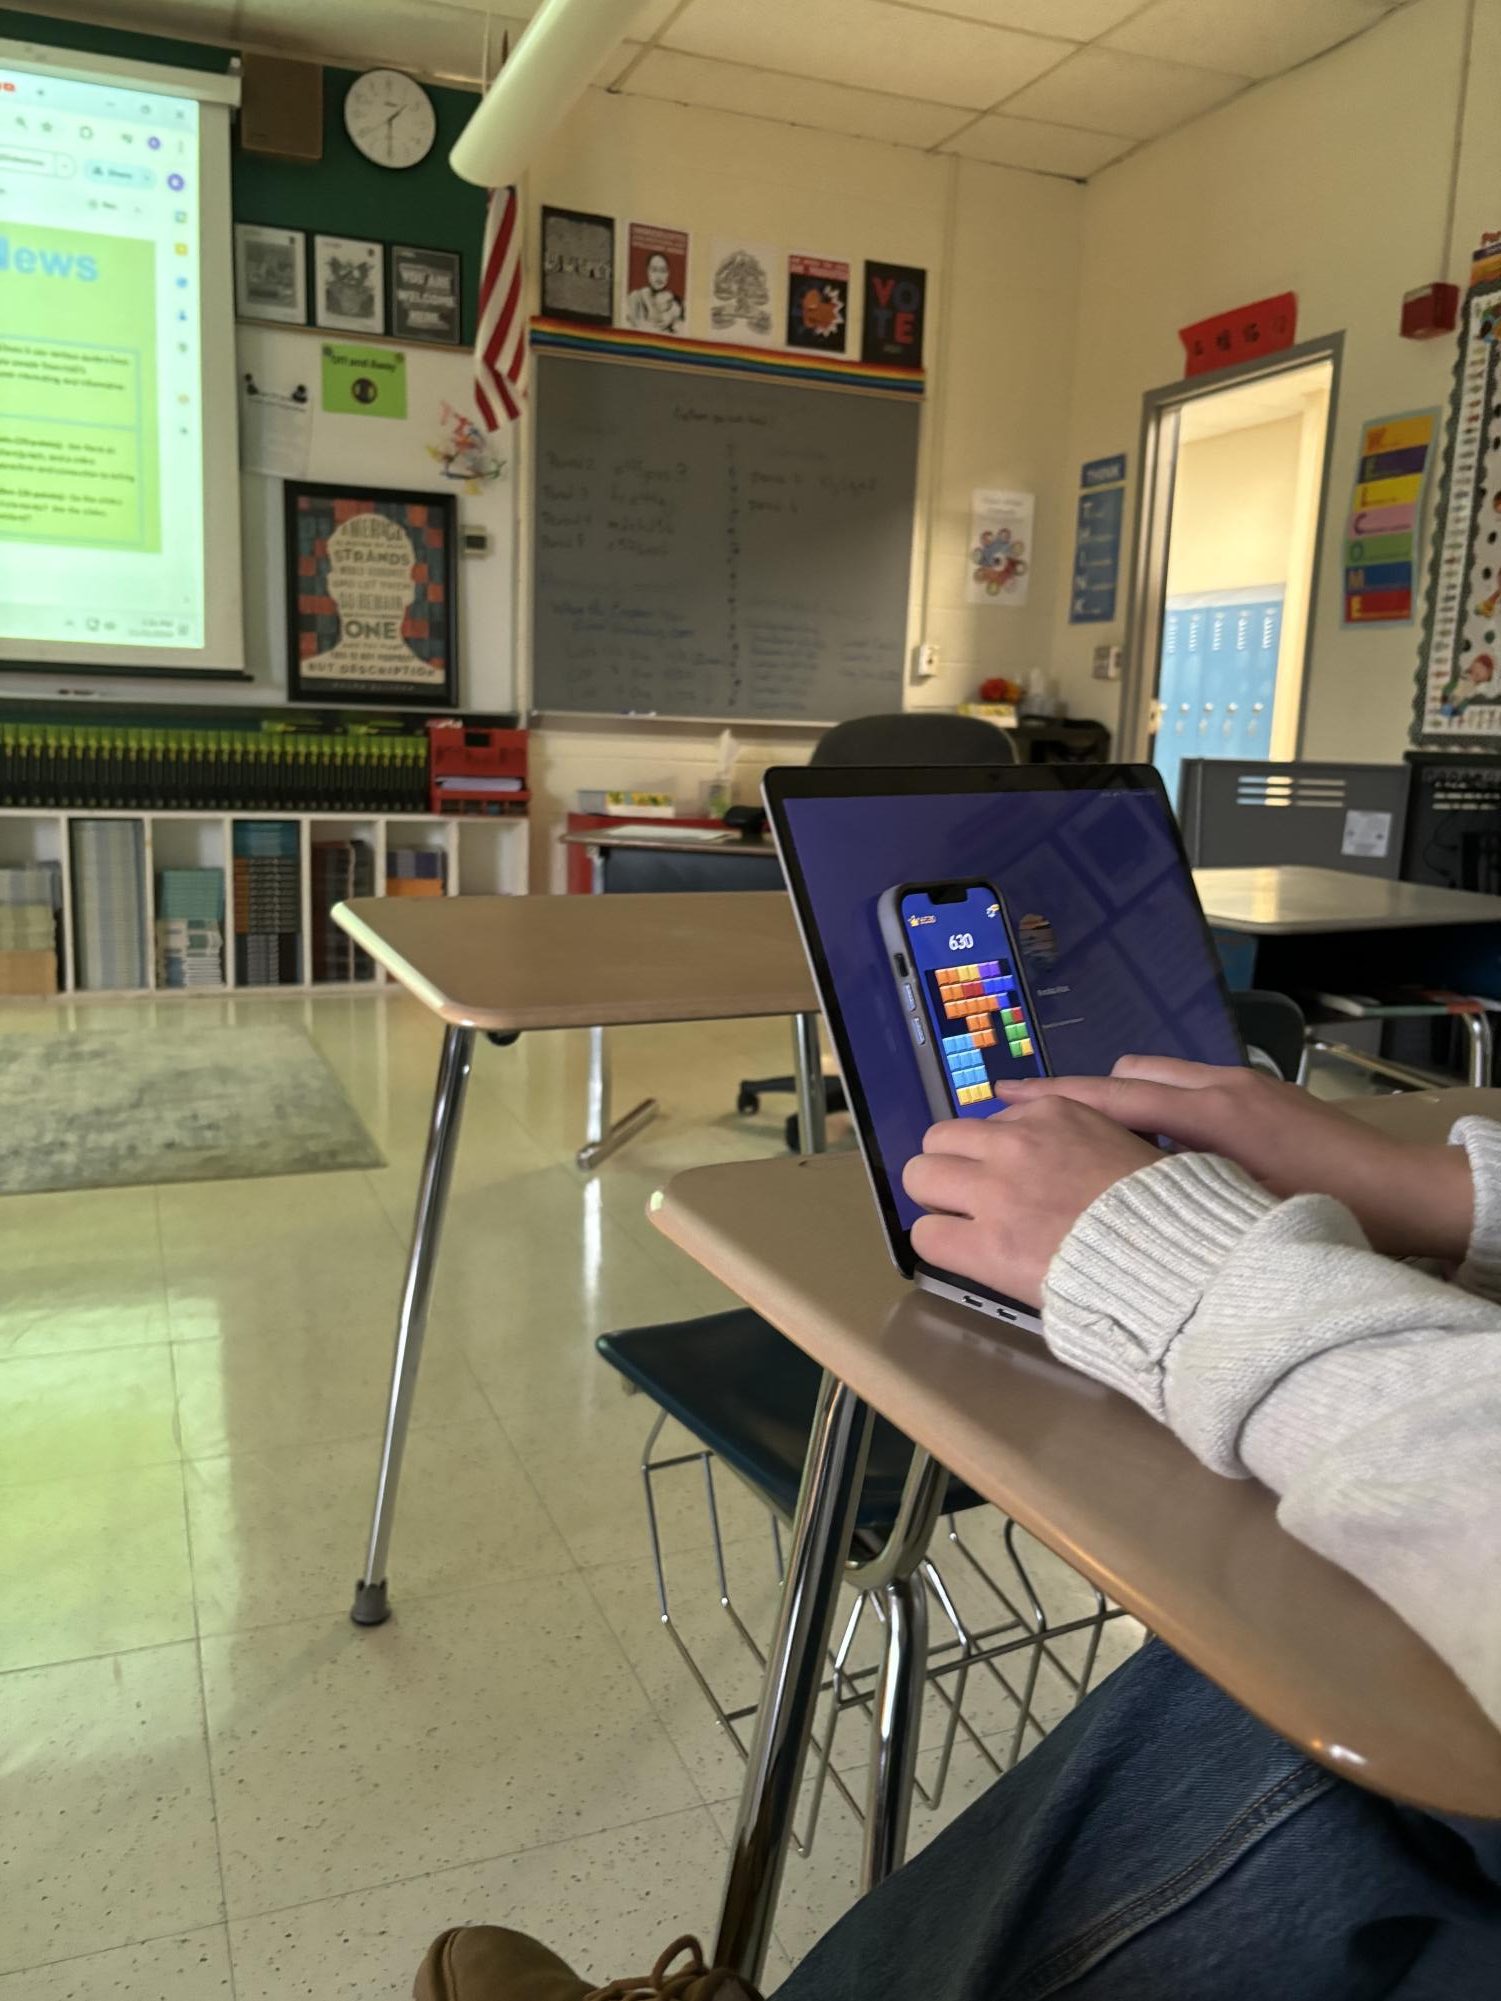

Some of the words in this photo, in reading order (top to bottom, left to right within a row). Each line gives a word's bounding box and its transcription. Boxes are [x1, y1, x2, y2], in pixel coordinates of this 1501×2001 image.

[332, 548, 410, 567] STRANDS
[345, 620, 397, 640] ONE
[308, 662, 336, 673] BUT
[341, 664, 436, 677] DESCRIPTION
[947, 932, 974, 951] 630
